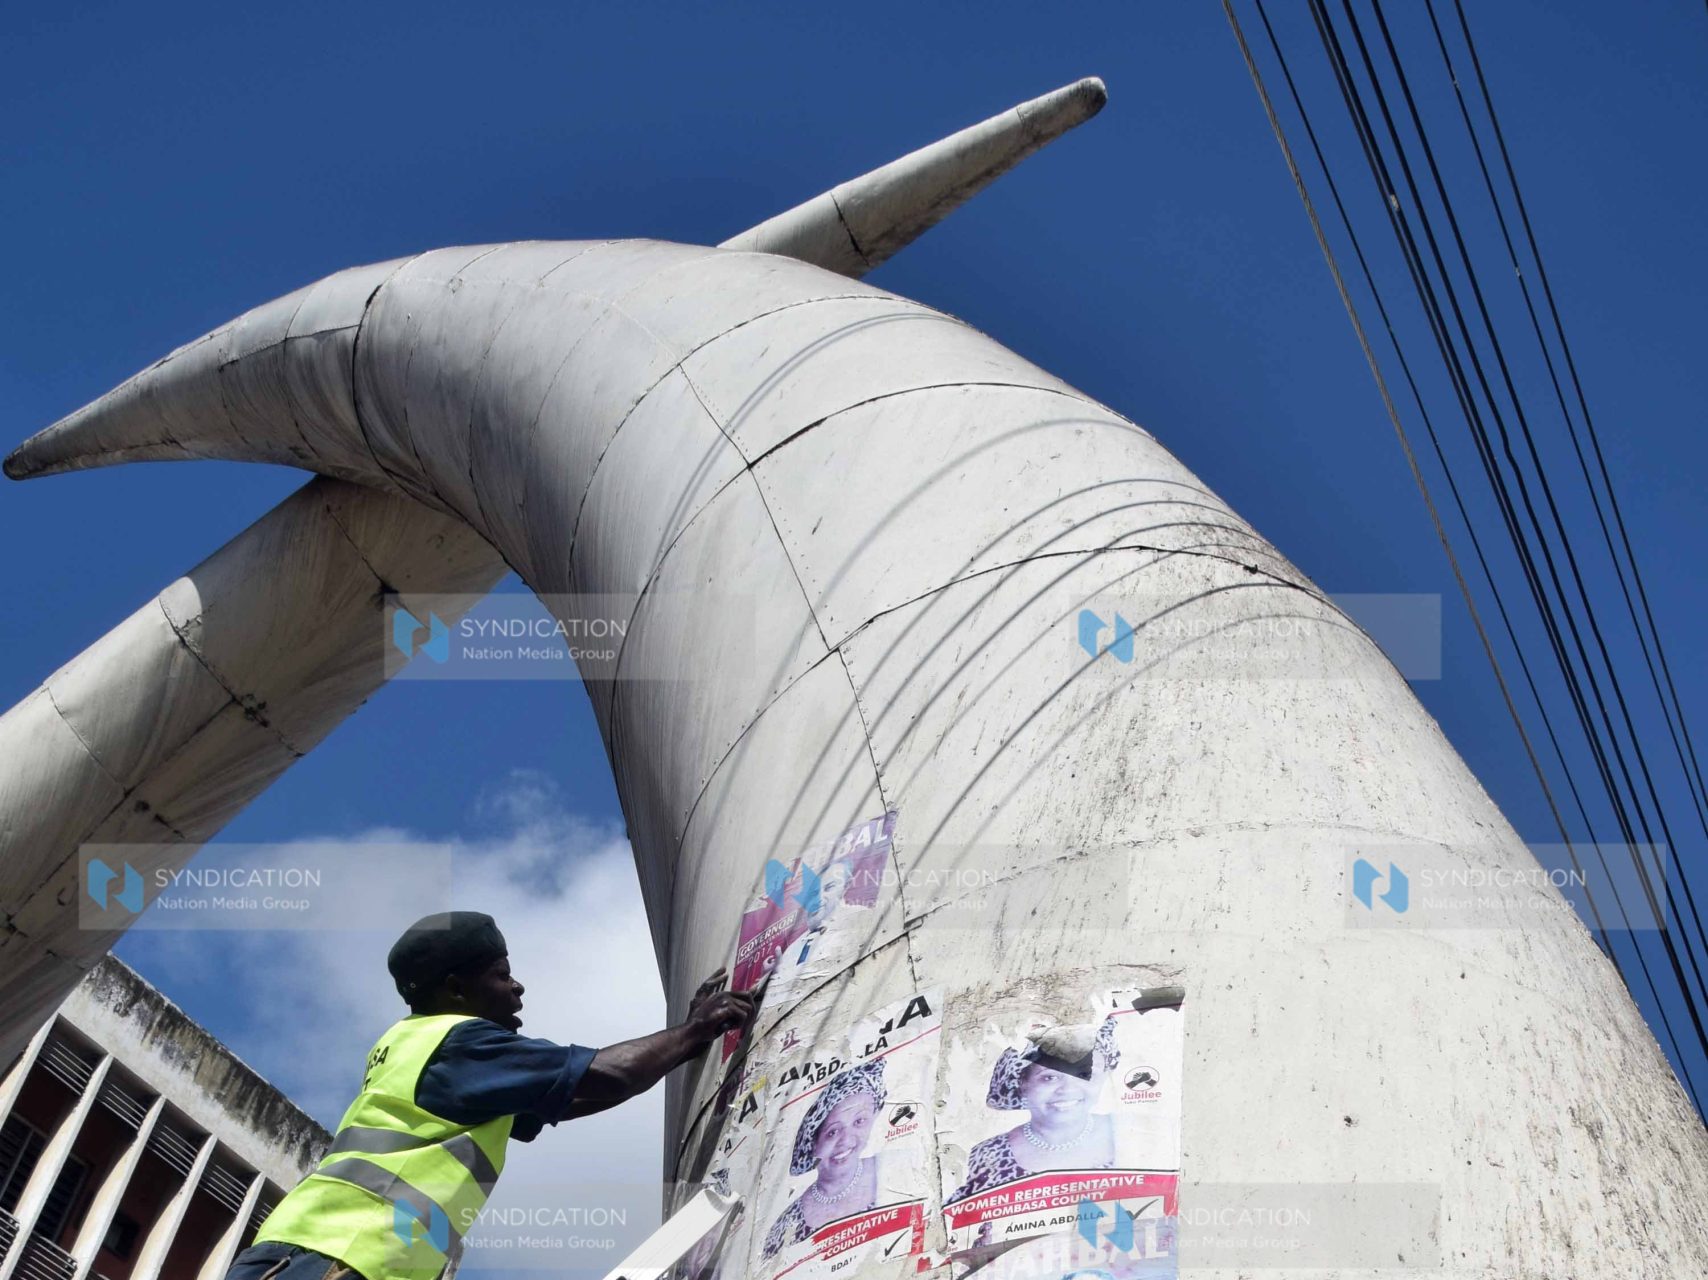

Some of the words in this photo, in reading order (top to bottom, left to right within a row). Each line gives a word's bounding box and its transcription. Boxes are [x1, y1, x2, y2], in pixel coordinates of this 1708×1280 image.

[740, 914, 795, 957] GOVERNOR
[1121, 1090, 1162, 1101] Jubilee
[951, 1194, 1010, 1217] WOMEN
[1014, 1174, 1145, 1202] REPRESENTATIVE
[981, 1199, 1047, 1220] MOMBASA
[1051, 1191, 1106, 1206] COUNTY
[1005, 1220, 1046, 1235] AMINA
[1049, 1211, 1105, 1227] ABDALLA
